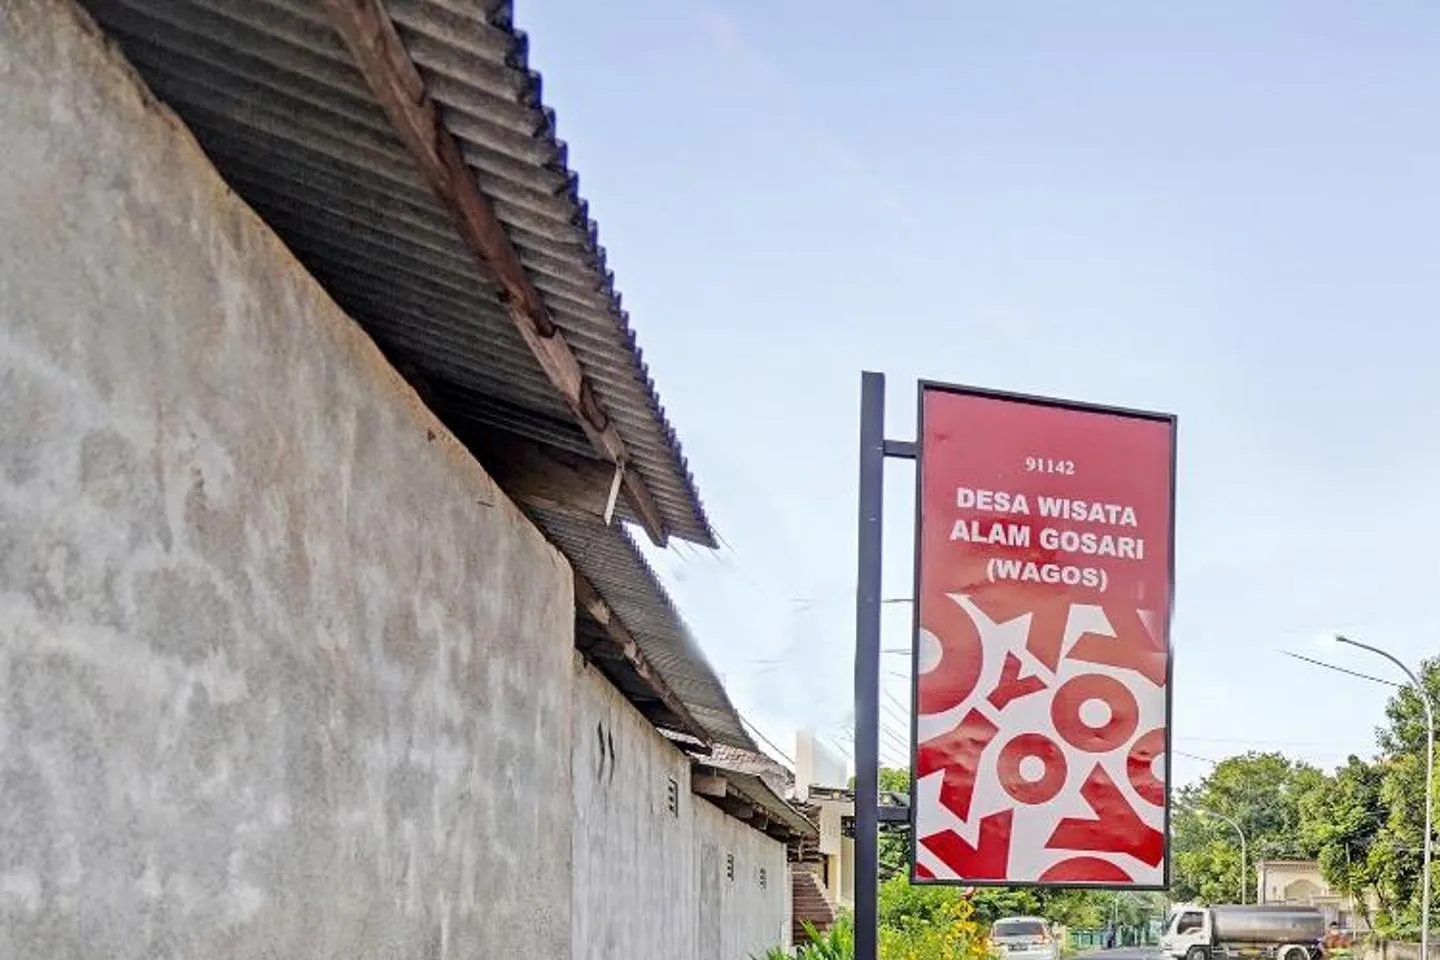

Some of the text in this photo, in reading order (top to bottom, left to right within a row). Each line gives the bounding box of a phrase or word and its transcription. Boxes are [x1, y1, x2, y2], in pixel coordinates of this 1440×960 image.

[1025, 456, 1076, 475] 91142
[956, 487, 1138, 527] DESA WISATA
[949, 519, 1144, 560] ALAM GOSARI
[986, 558, 1109, 592] (WAGOS)
